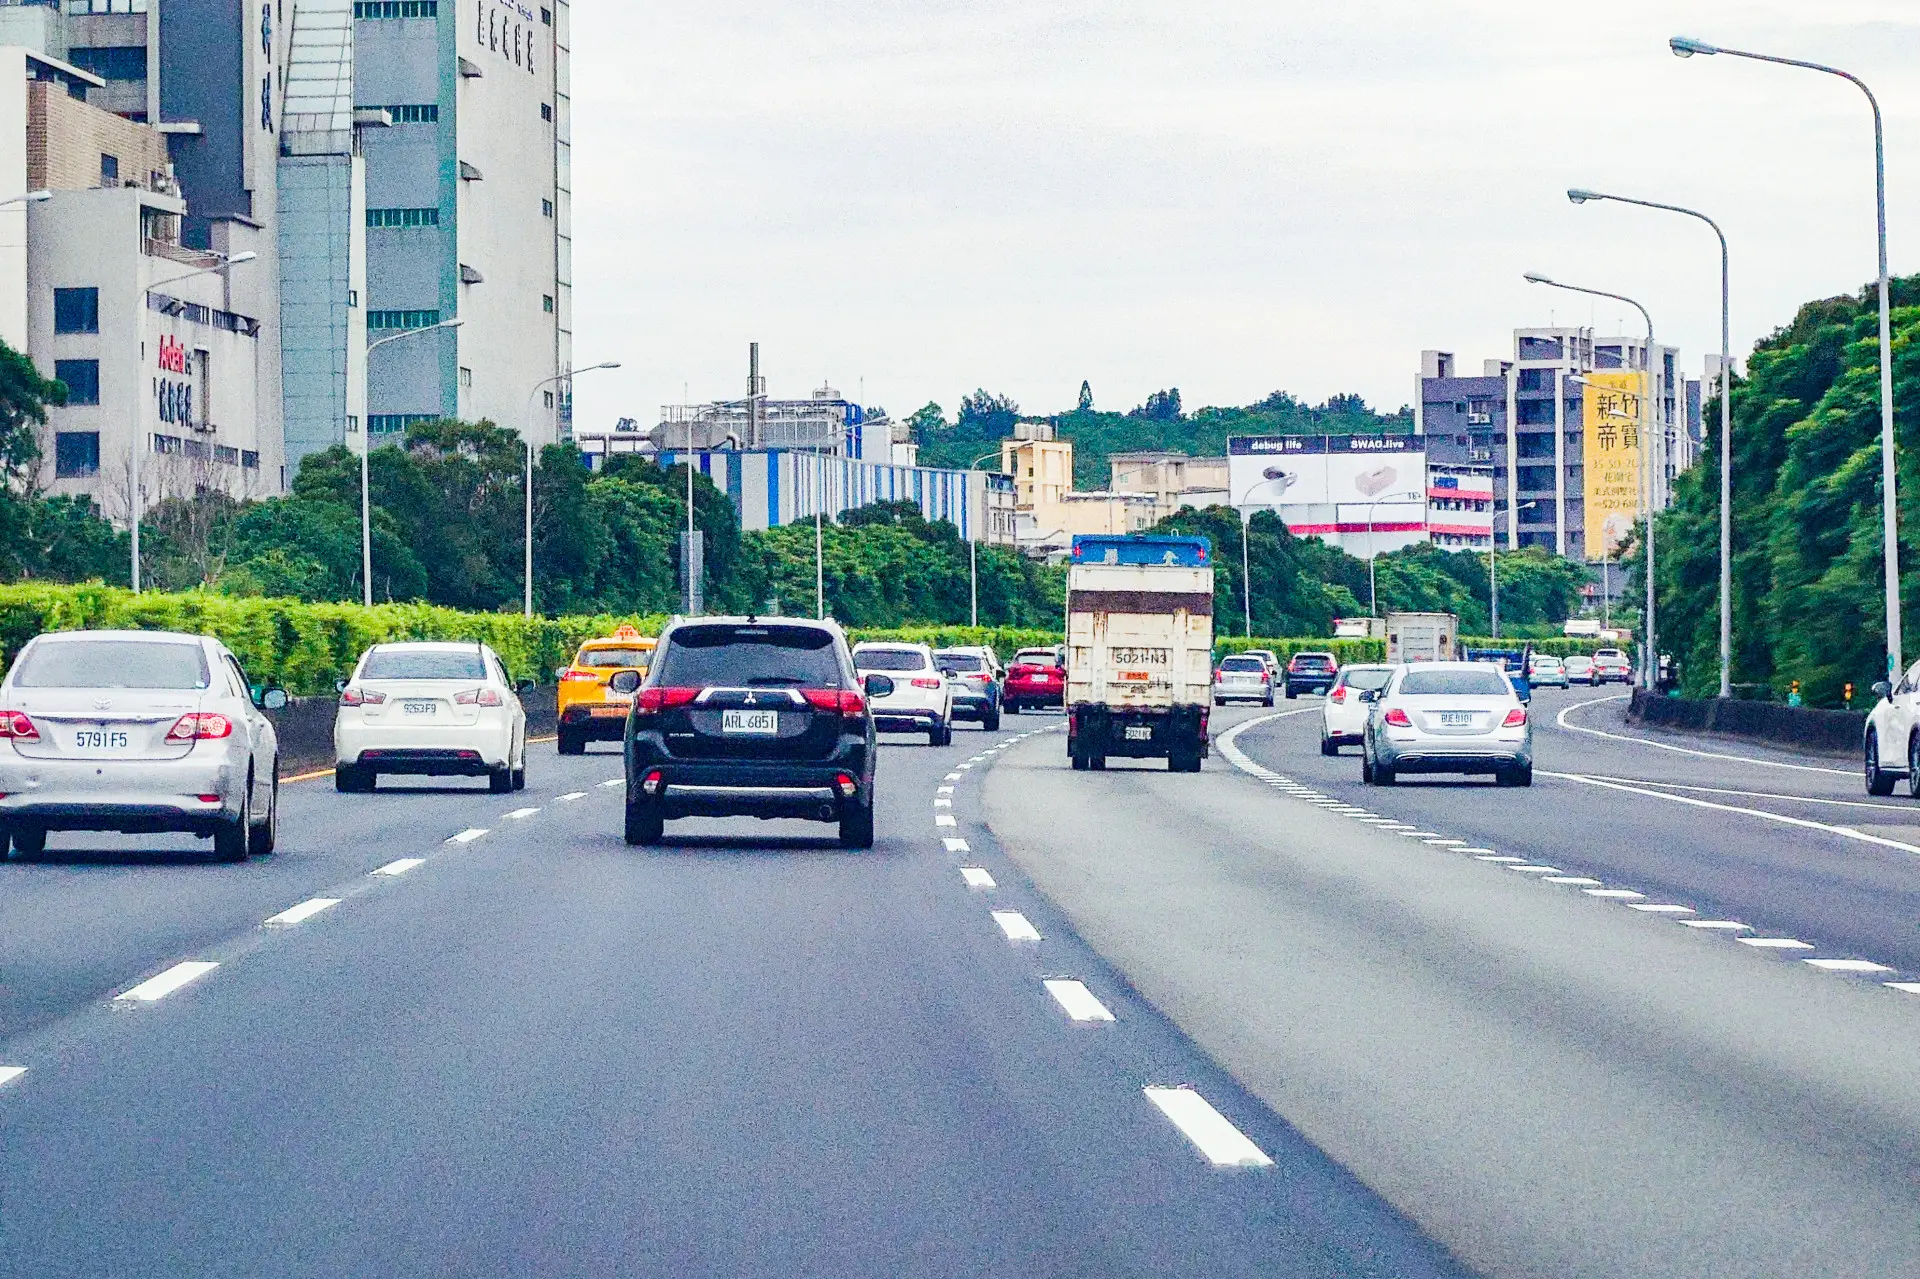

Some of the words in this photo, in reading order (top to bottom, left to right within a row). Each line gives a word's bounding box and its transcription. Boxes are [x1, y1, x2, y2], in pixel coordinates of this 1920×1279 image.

[1597, 393, 1639, 420] 新竹
[1597, 422, 1640, 451] 帝寶
[1251, 439, 1283, 451] debug
[1286, 440, 1302, 449] life
[1350, 439, 1404, 449] SWAG.live
[1115, 653, 1167, 664] 5021-N3
